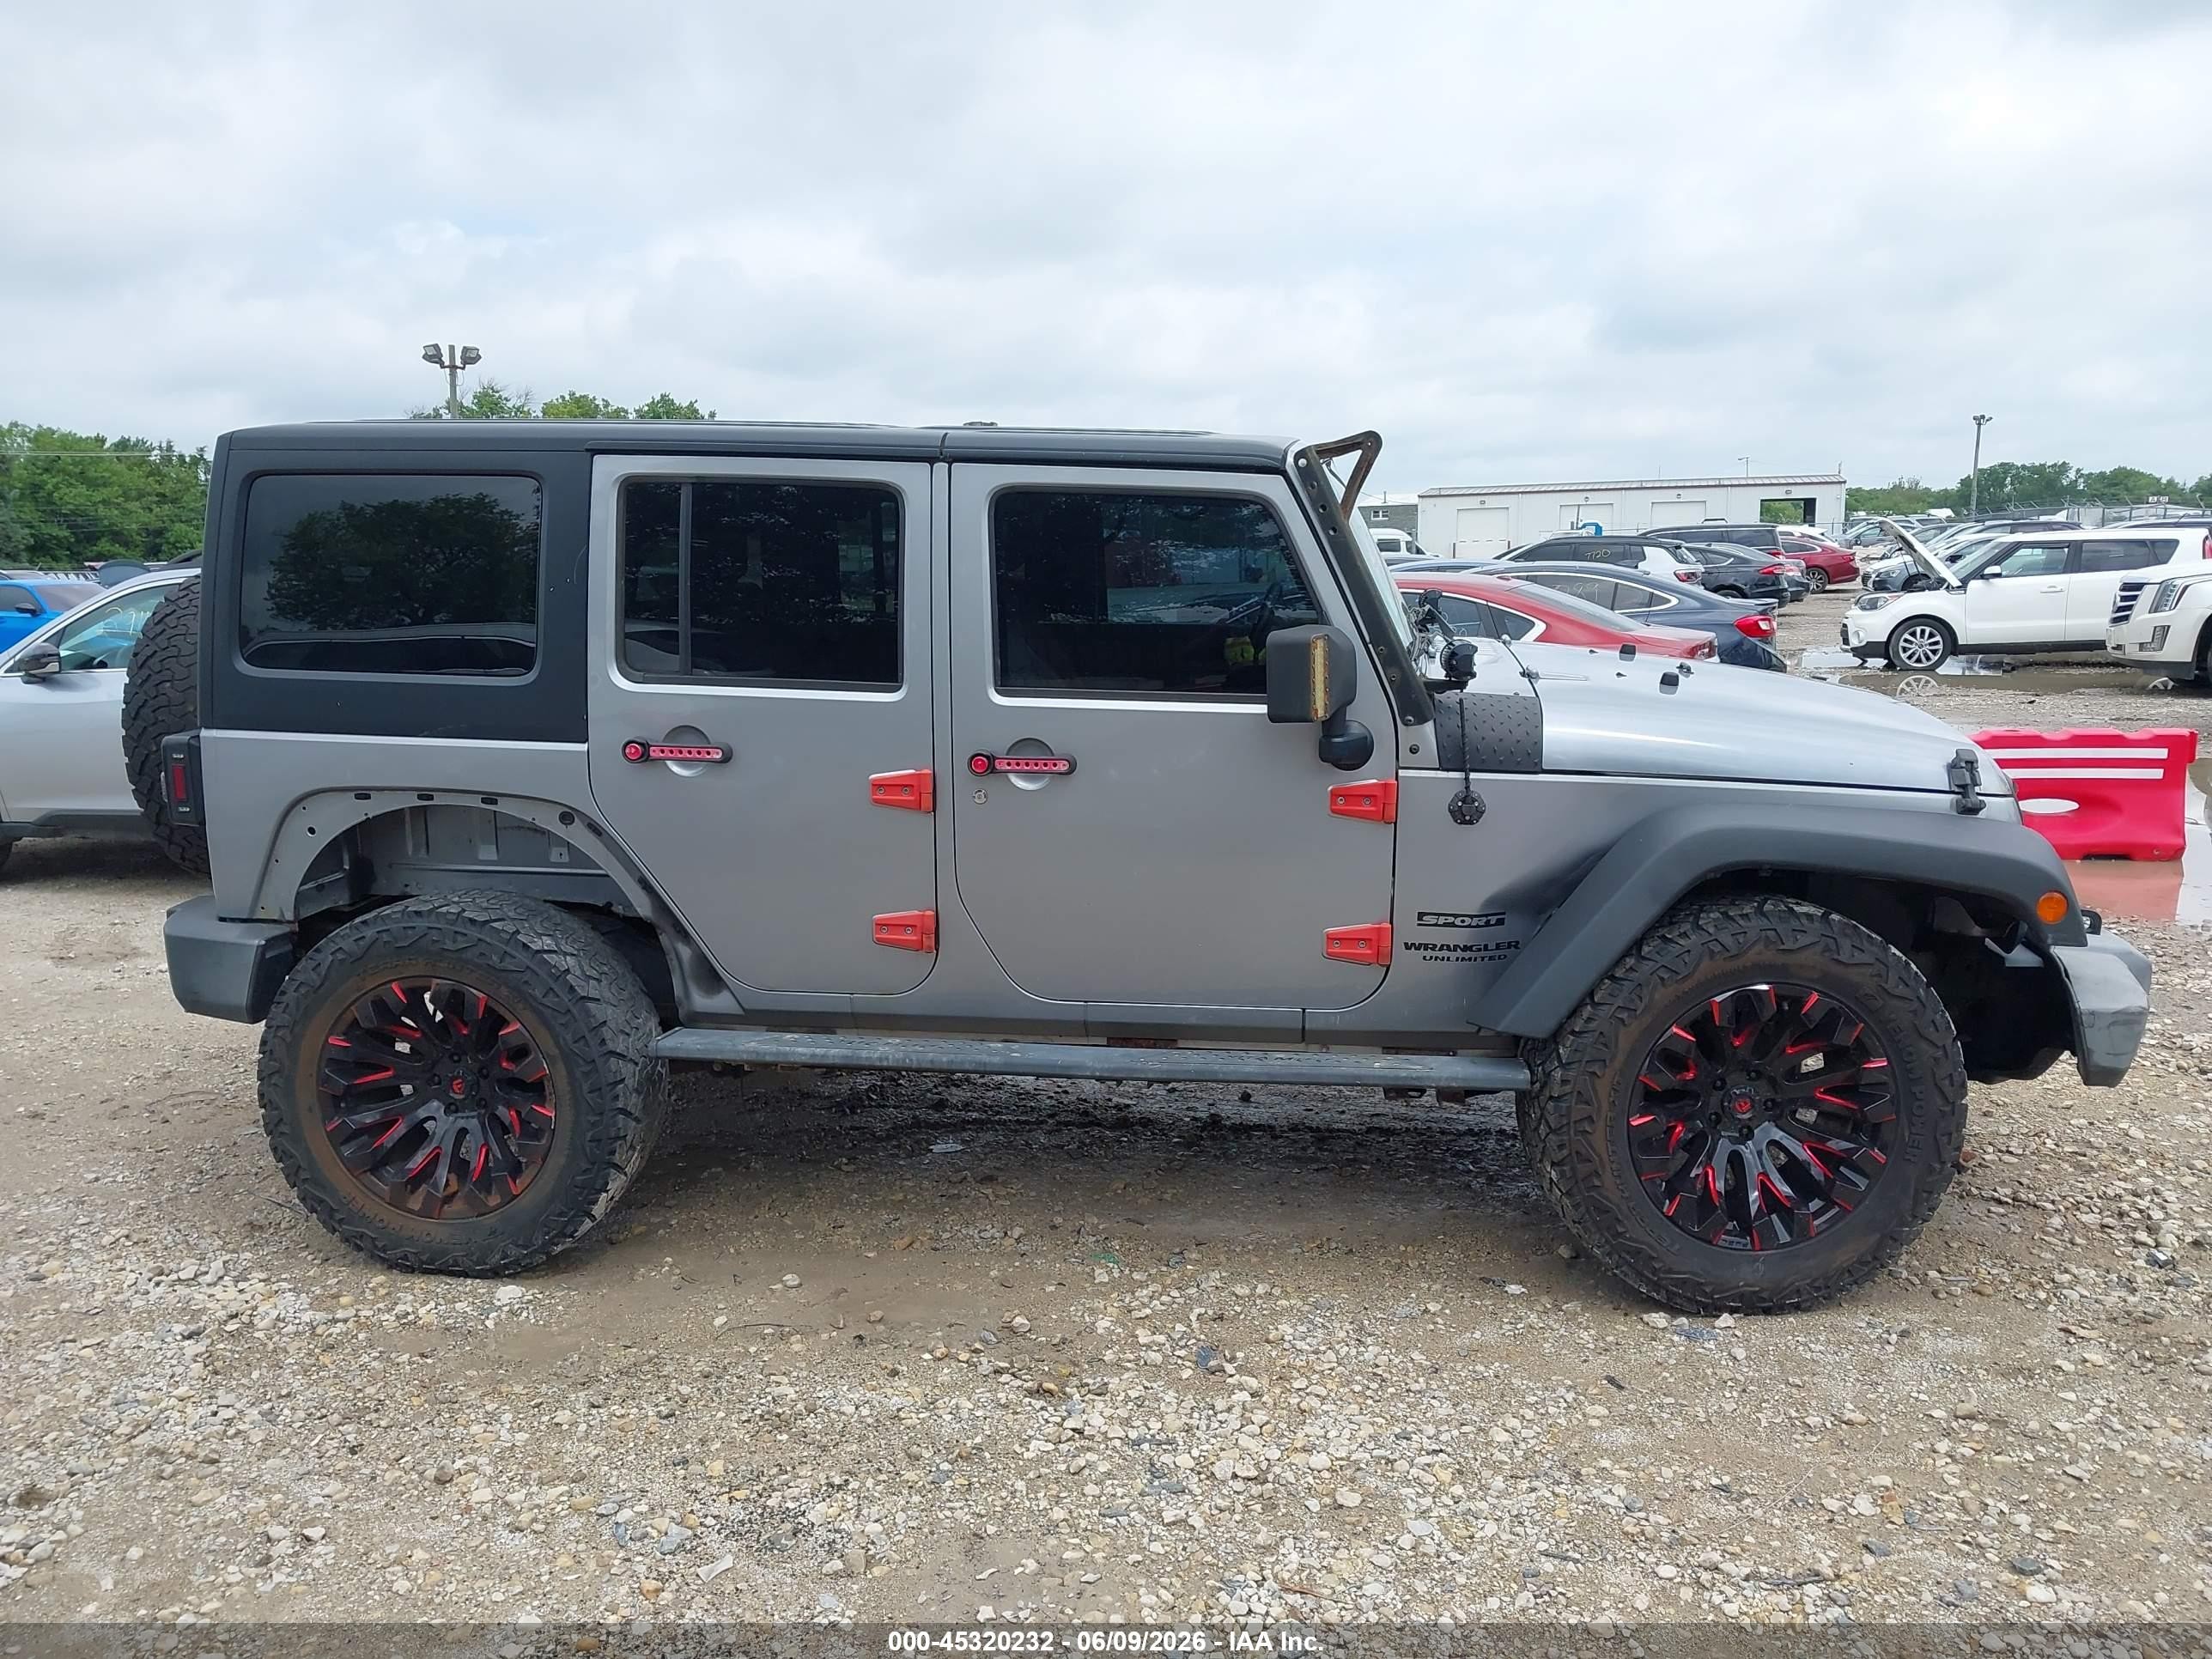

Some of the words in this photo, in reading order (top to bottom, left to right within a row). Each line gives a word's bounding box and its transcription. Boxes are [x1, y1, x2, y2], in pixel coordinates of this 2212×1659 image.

[1421, 915, 1504, 927] SPORT
[1403, 940, 1521, 952] WRANGLER
[1422, 953, 1508, 963] UNLIMITED
[1903, 1085, 1927, 1164] POWER
